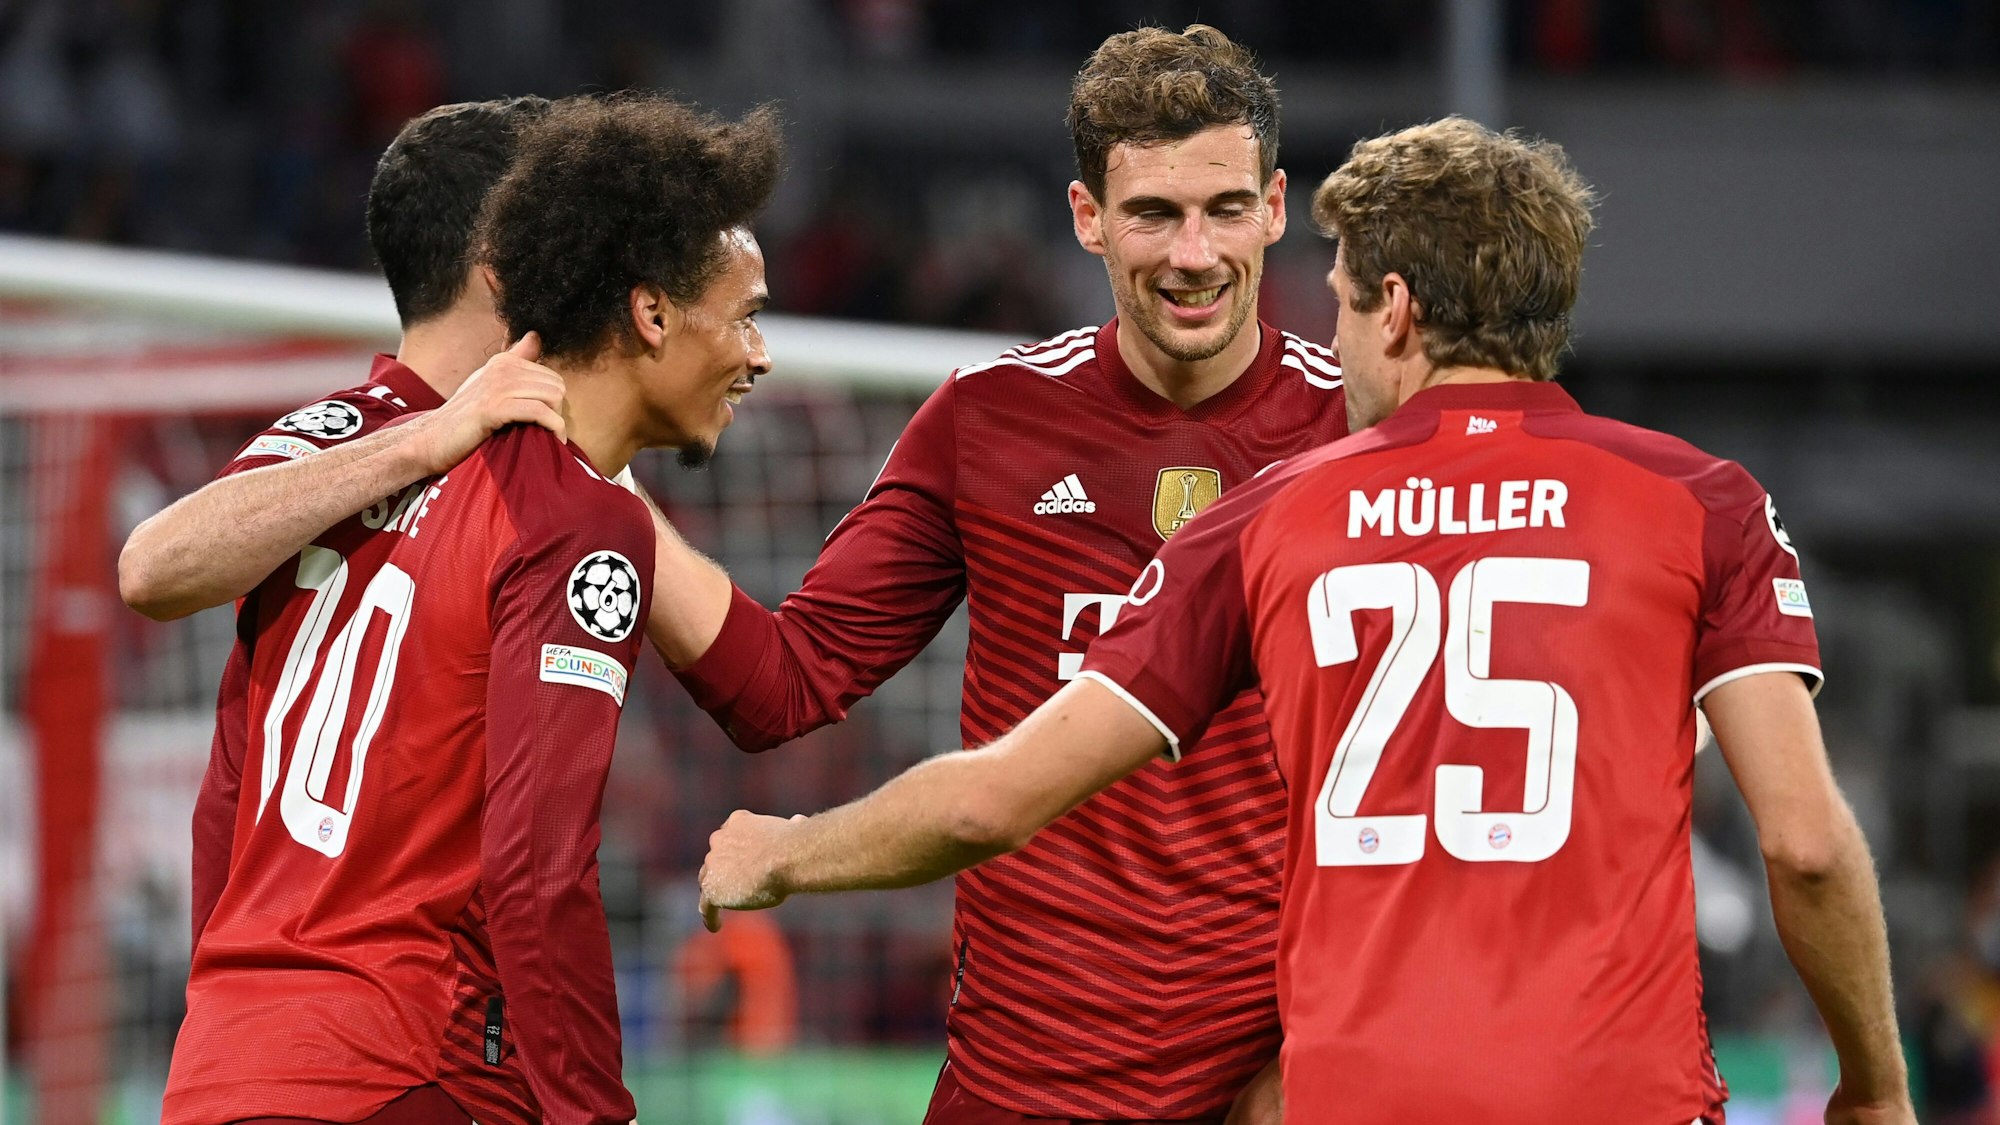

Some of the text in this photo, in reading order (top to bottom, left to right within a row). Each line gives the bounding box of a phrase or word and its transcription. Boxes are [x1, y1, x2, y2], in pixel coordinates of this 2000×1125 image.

[1033, 497, 1096, 515] adidas
[1347, 477, 1568, 538] MÜLLER
[598, 580, 618, 613] 6
[546, 646, 572, 656] UEFA
[1058, 592, 1128, 680] T
[545, 656, 625, 693] FOUNDATION
[255, 544, 416, 858] 10
[1307, 557, 1590, 866] 25
